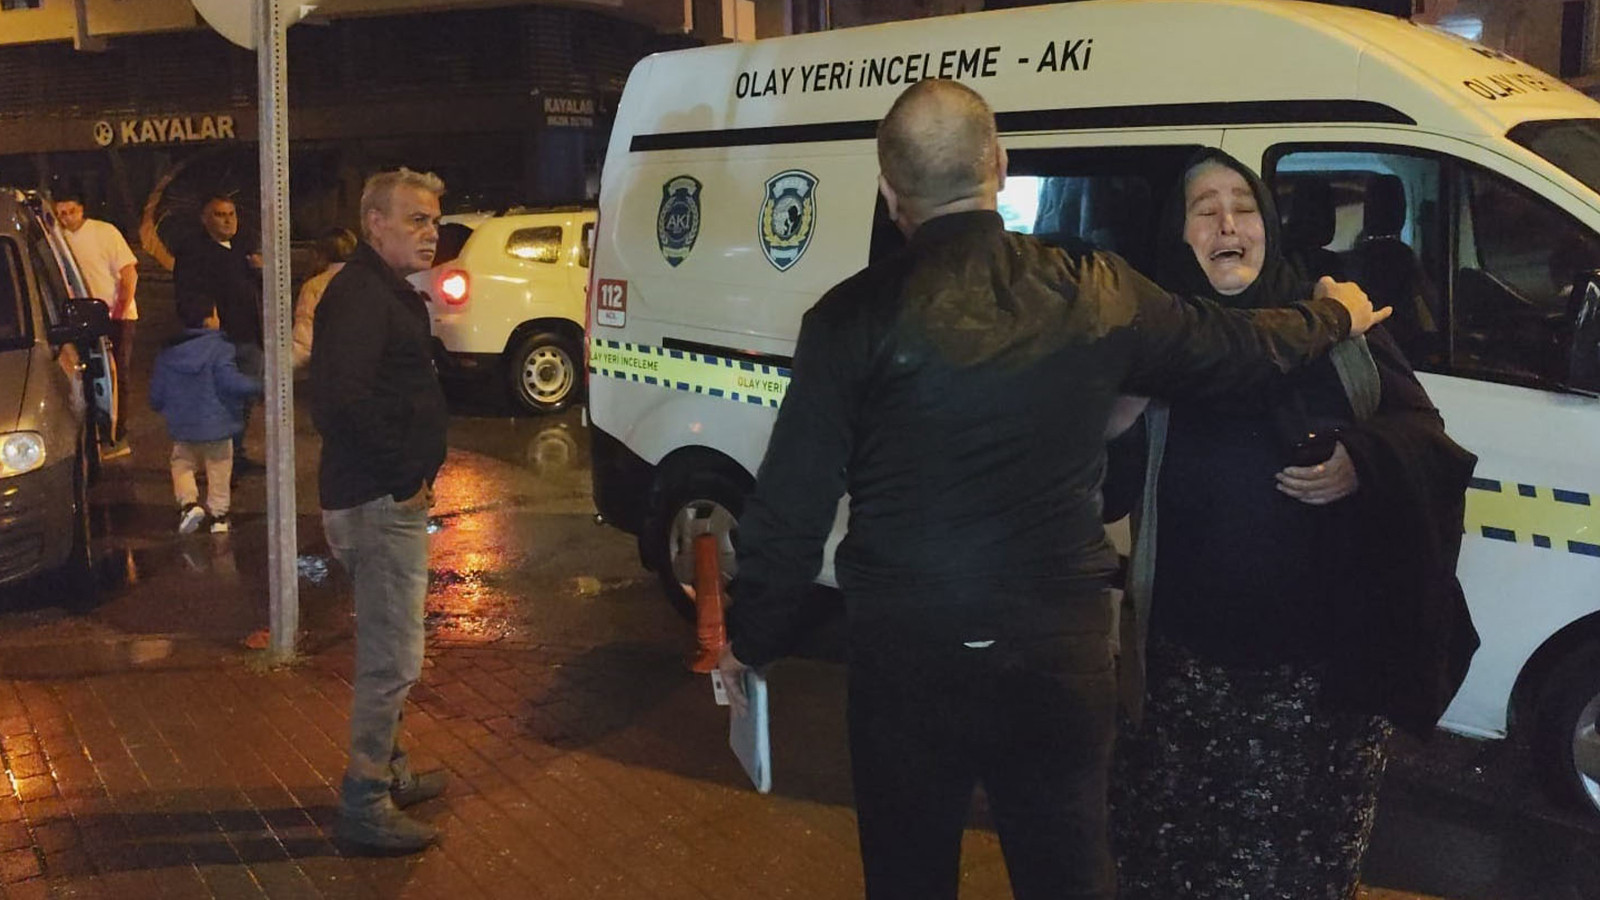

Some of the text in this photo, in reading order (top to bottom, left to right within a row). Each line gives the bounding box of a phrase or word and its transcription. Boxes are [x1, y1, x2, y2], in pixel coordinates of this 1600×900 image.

[736, 67, 795, 99] OLAY
[120, 115, 235, 144] KAYALAR
[601, 284, 623, 308] 112
[738, 377, 760, 389] OLAY
